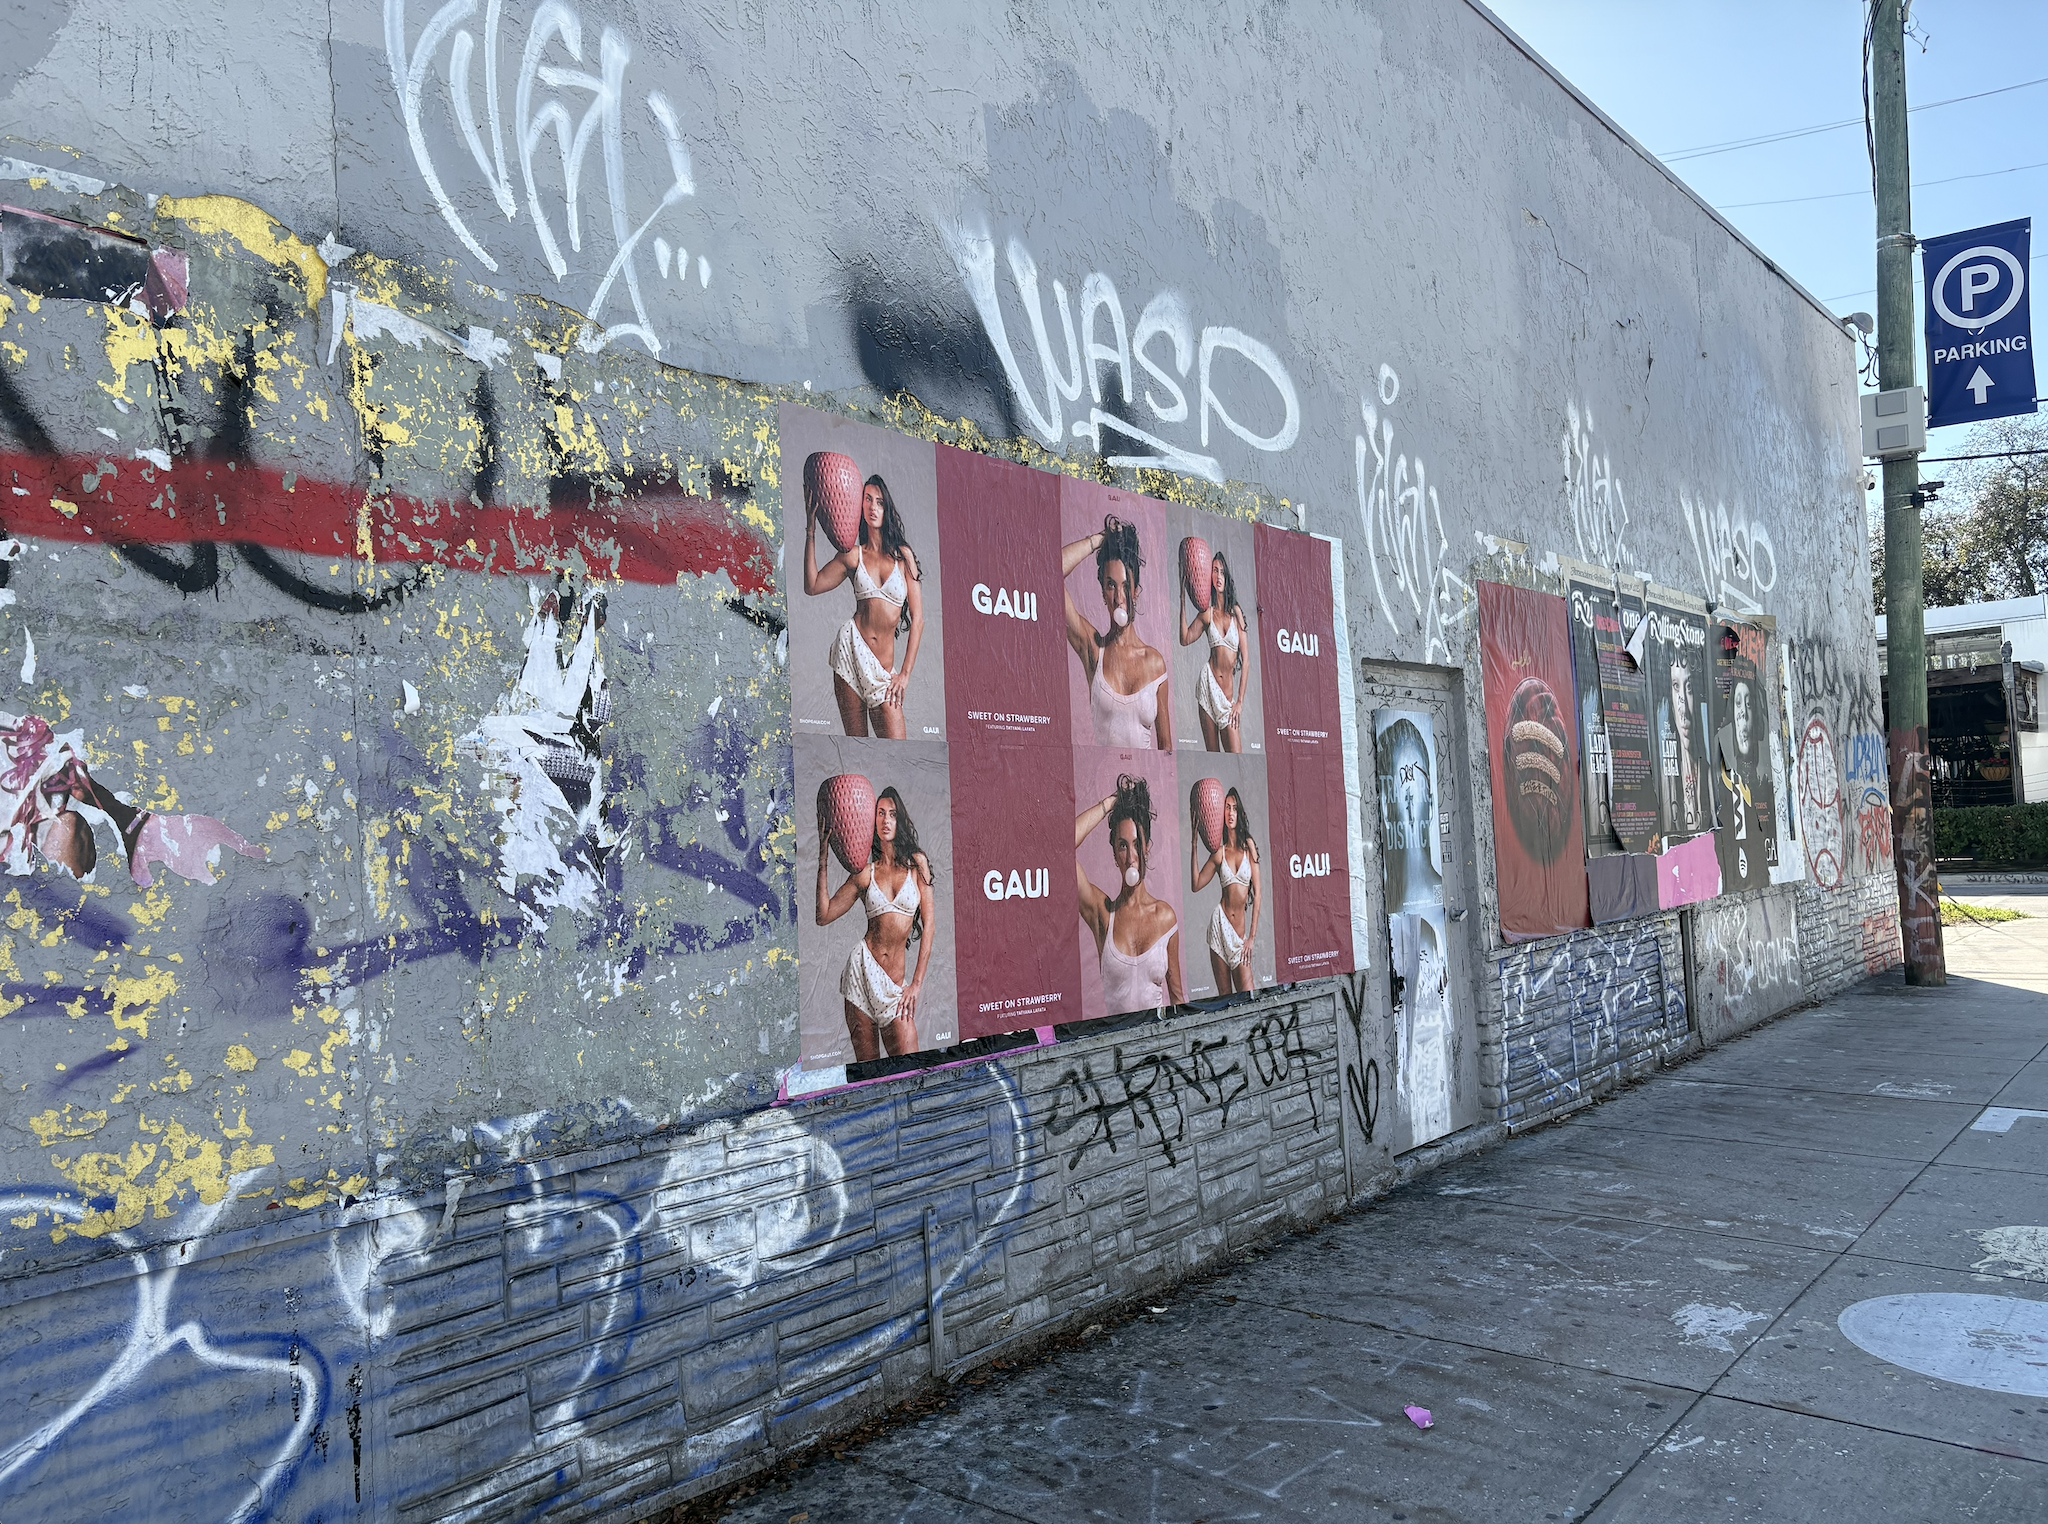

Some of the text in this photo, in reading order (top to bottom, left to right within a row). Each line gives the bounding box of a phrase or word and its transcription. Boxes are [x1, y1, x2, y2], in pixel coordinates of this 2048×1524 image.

[1960, 263, 2000, 312] P
[1934, 335, 2028, 365] PARKING
[971, 583, 1038, 622] GAUI
[1276, 628, 1320, 657] GAUI
[923, 726, 940, 735] GAUI
[967, 710, 1051, 725] SWEET ON STRAWBERRY
[1289, 852, 1331, 879] GAUI
[983, 867, 1050, 901] GAUI
[979, 992, 1063, 1013] SWEET ON STRAWBERRY
[935, 1031, 952, 1041] GAUI
